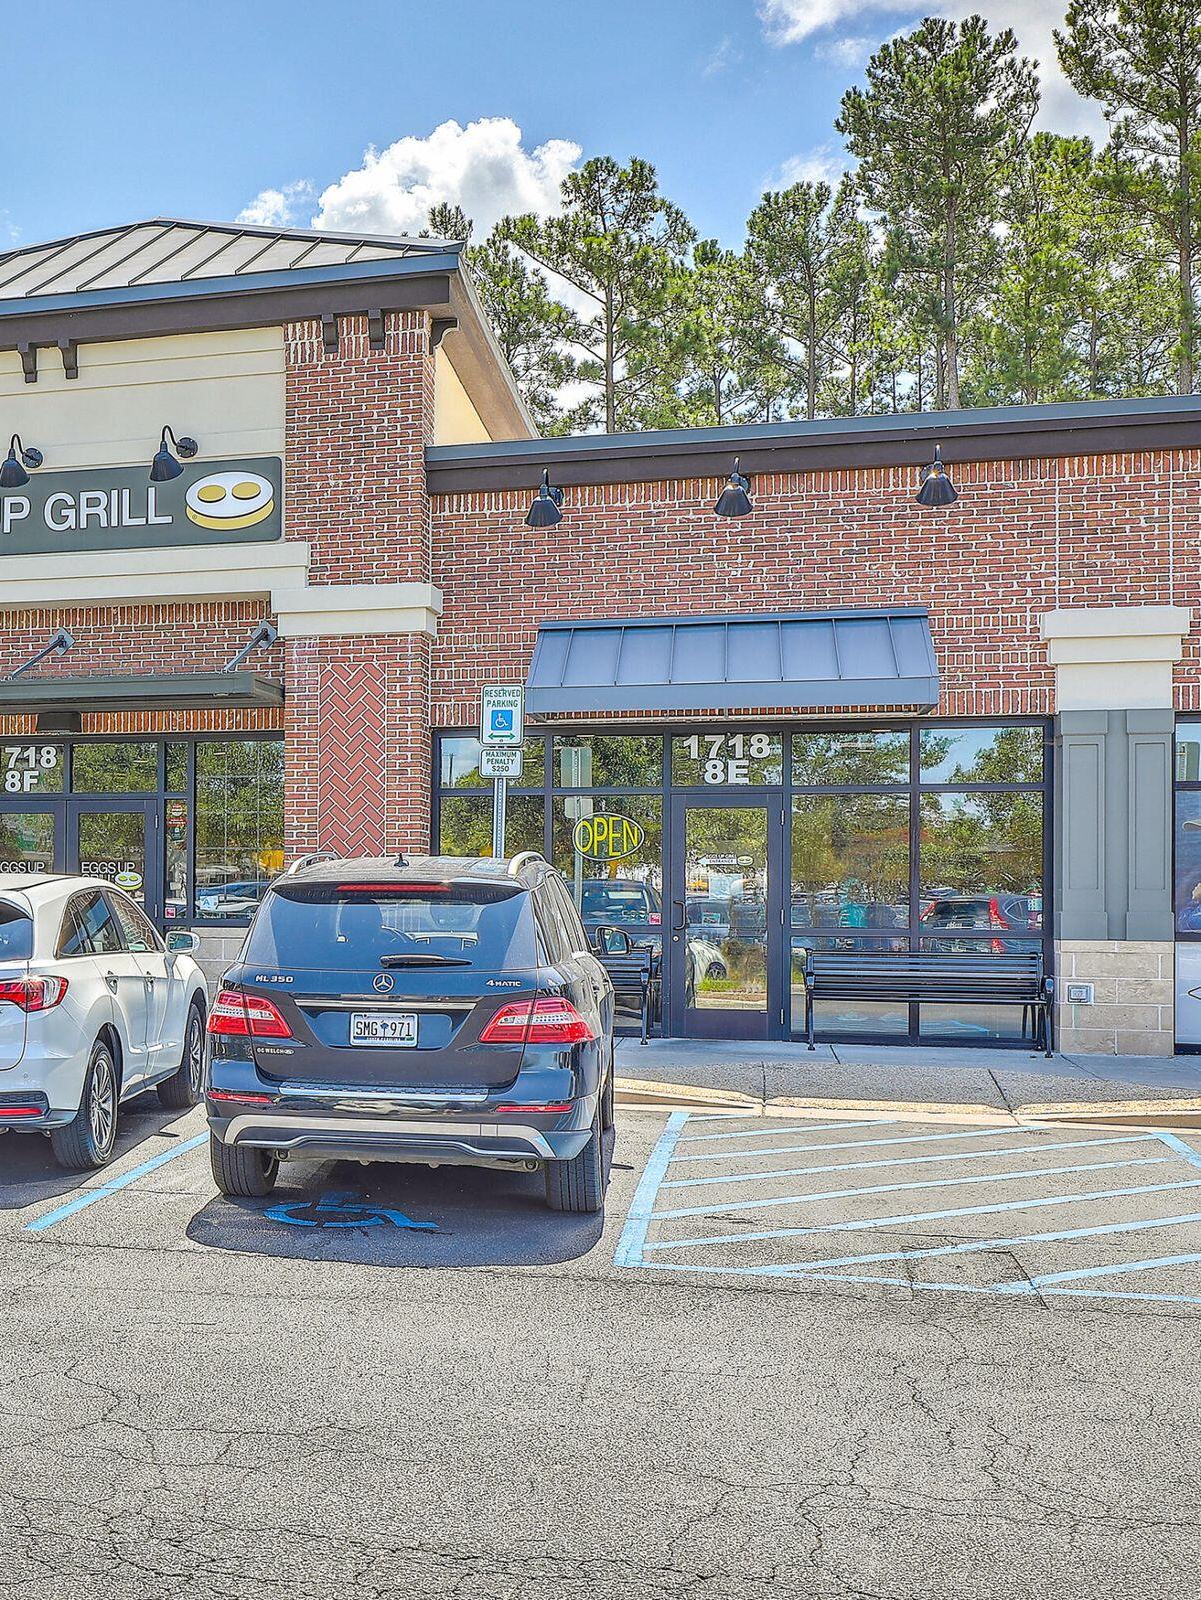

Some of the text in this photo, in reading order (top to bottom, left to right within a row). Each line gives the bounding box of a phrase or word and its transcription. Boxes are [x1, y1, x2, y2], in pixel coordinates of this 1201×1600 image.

[43, 486, 174, 532] GRILL
[485, 688, 521, 698] RESERVED
[487, 699, 519, 708] PARKING
[683, 733, 771, 760] 1718
[704, 759, 750, 784] 8E
[4, 770, 39, 792] 8F
[574, 816, 639, 857] OPEN
[27, 861, 45, 874] UP
[81, 861, 136, 874] EGGS UP
[486, 979, 521, 987] 4MATIC
[355, 1021, 412, 1038] SMG 971
